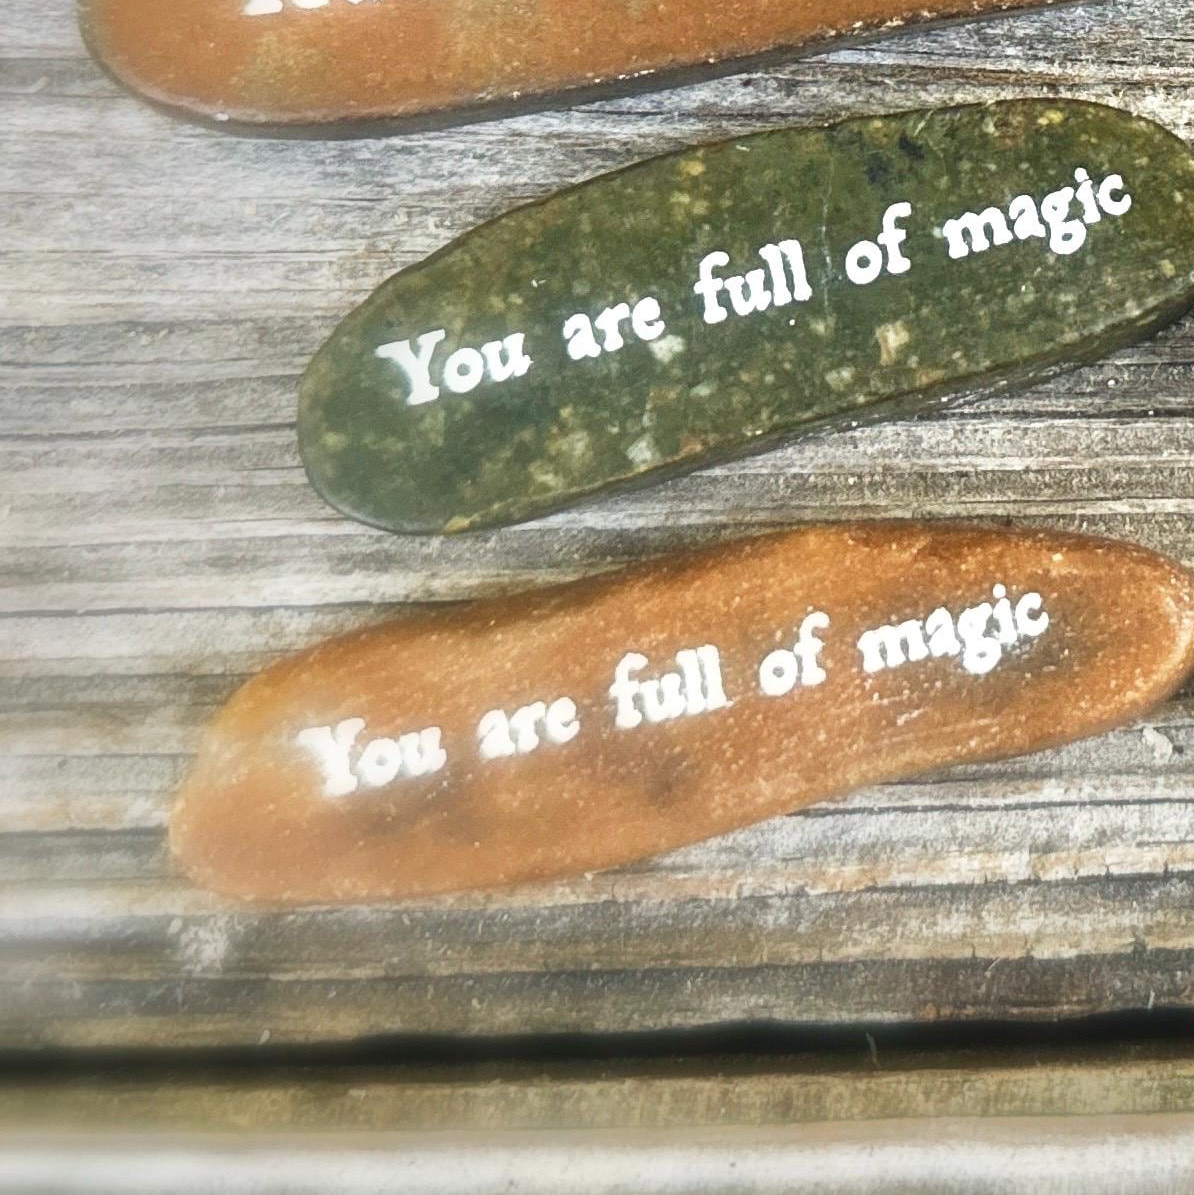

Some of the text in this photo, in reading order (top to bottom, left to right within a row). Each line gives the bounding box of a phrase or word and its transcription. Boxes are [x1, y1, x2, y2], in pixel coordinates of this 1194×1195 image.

[377, 168, 1131, 404] You are full of magic
[299, 584, 1048, 796] You are full of magic
